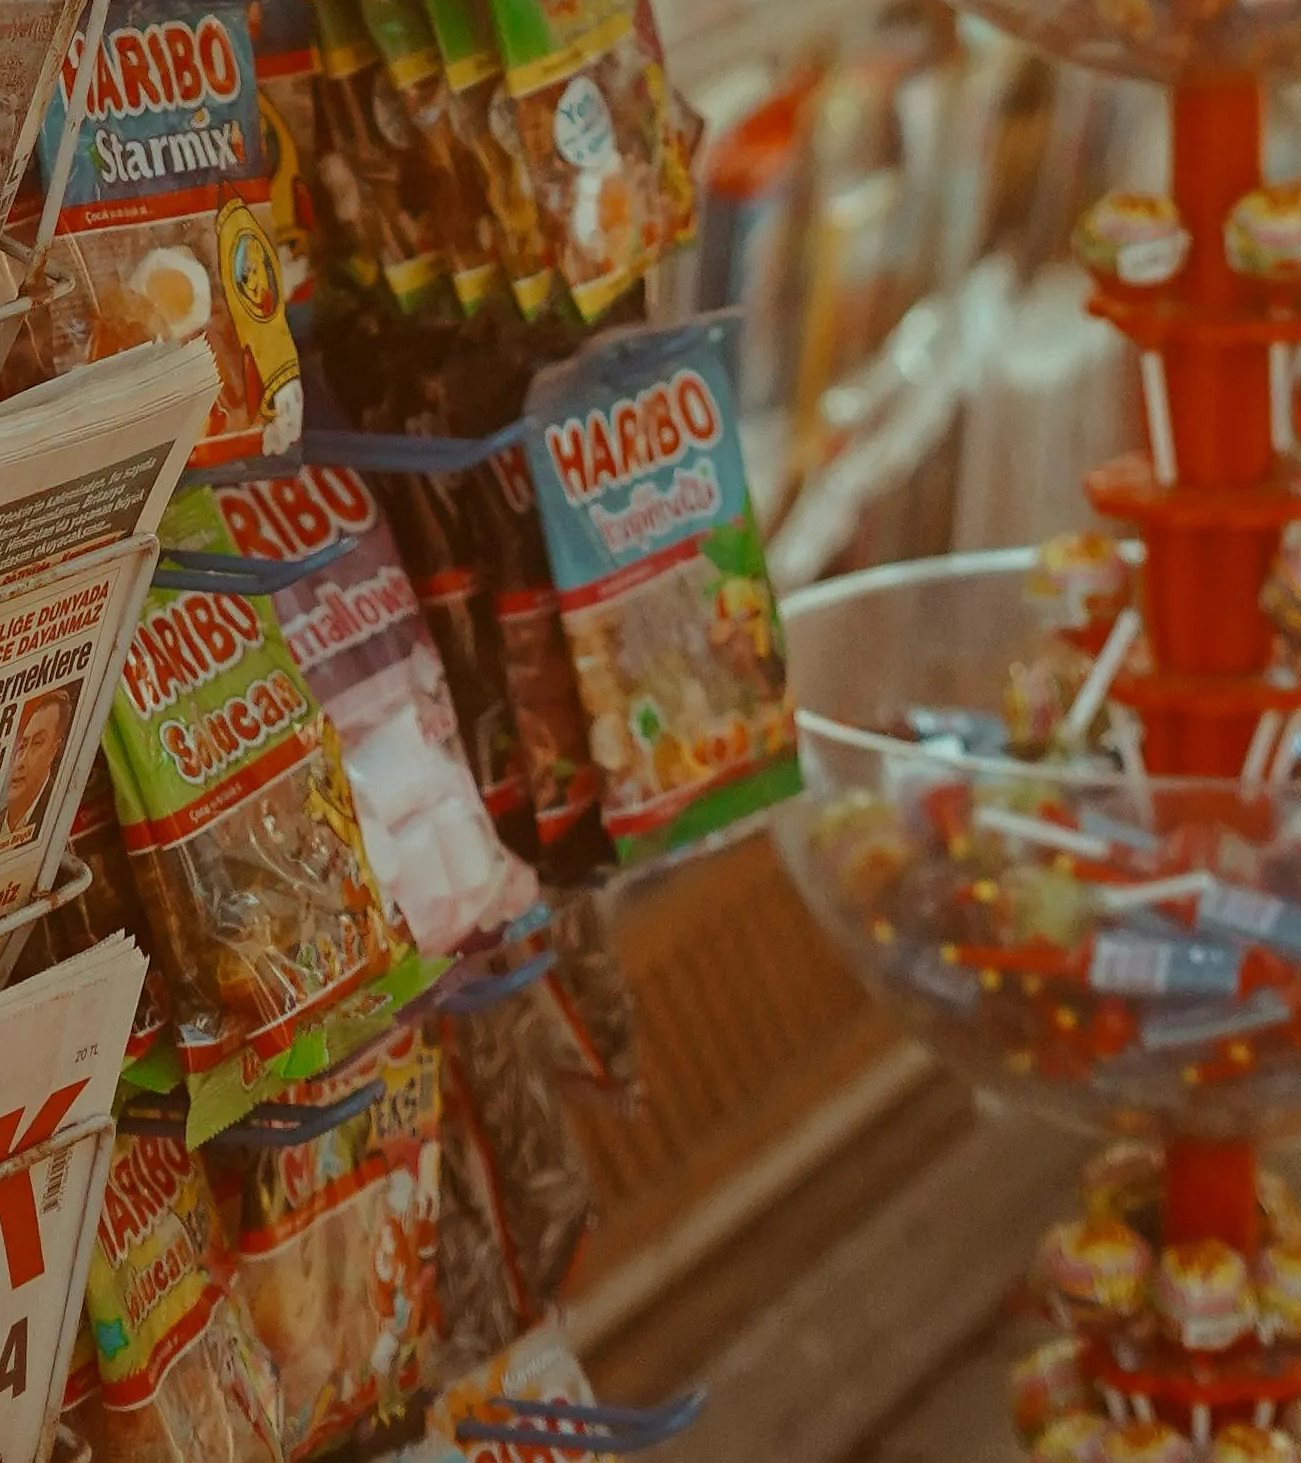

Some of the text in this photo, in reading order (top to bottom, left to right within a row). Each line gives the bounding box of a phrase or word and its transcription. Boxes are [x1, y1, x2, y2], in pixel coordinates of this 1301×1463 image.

[58, 14, 242, 120] HARIBO
[97, 110, 237, 185] Starmix
[546, 372, 720, 502] HARIBO
[219, 465, 374, 563] RIBO
[17, 603, 104, 656] DAYANMAZ
[37, 579, 110, 627] DÜNYADA
[125, 590, 262, 719] HARIBO
